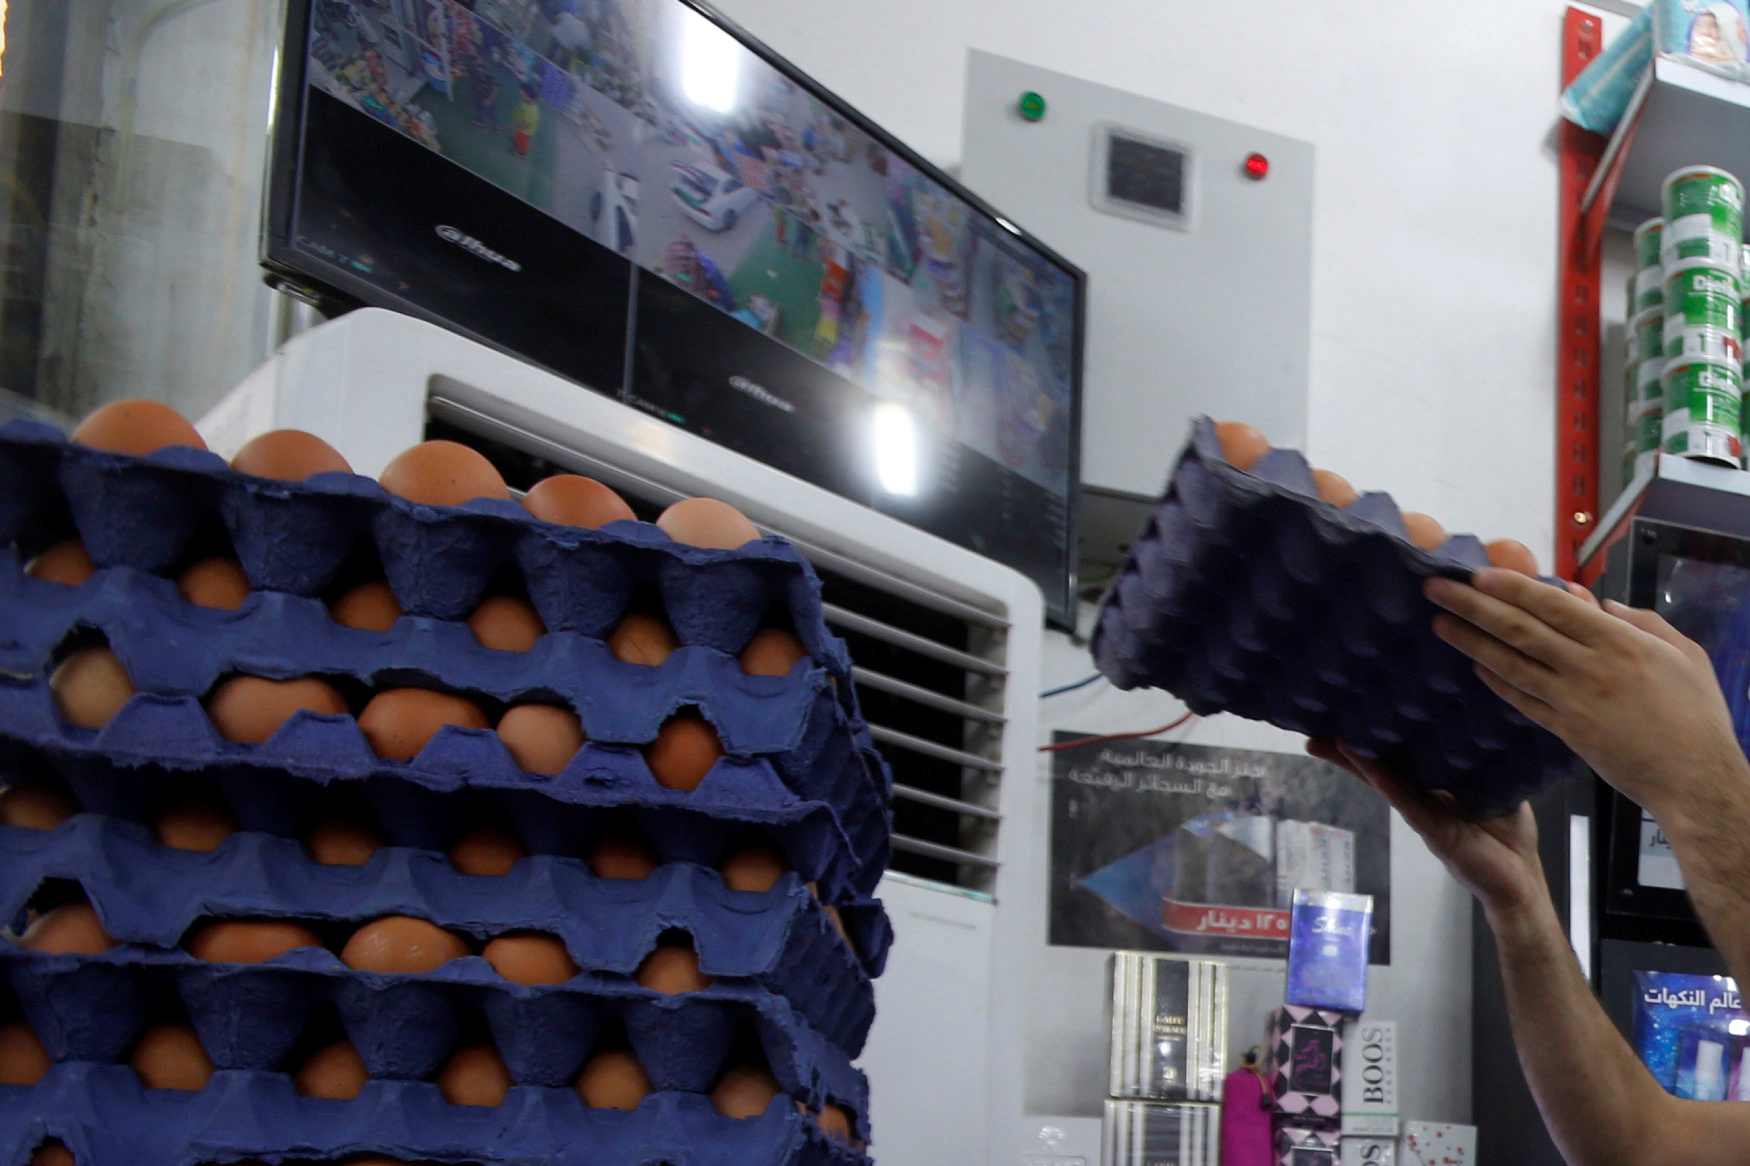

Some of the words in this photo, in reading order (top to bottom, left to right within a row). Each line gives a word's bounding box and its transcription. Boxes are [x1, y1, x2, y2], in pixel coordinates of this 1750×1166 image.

[1197, 910, 1252, 933] دينار
[1644, 987, 1706, 1008] النكهات
[1362, 1027, 1385, 1104] BOOS
